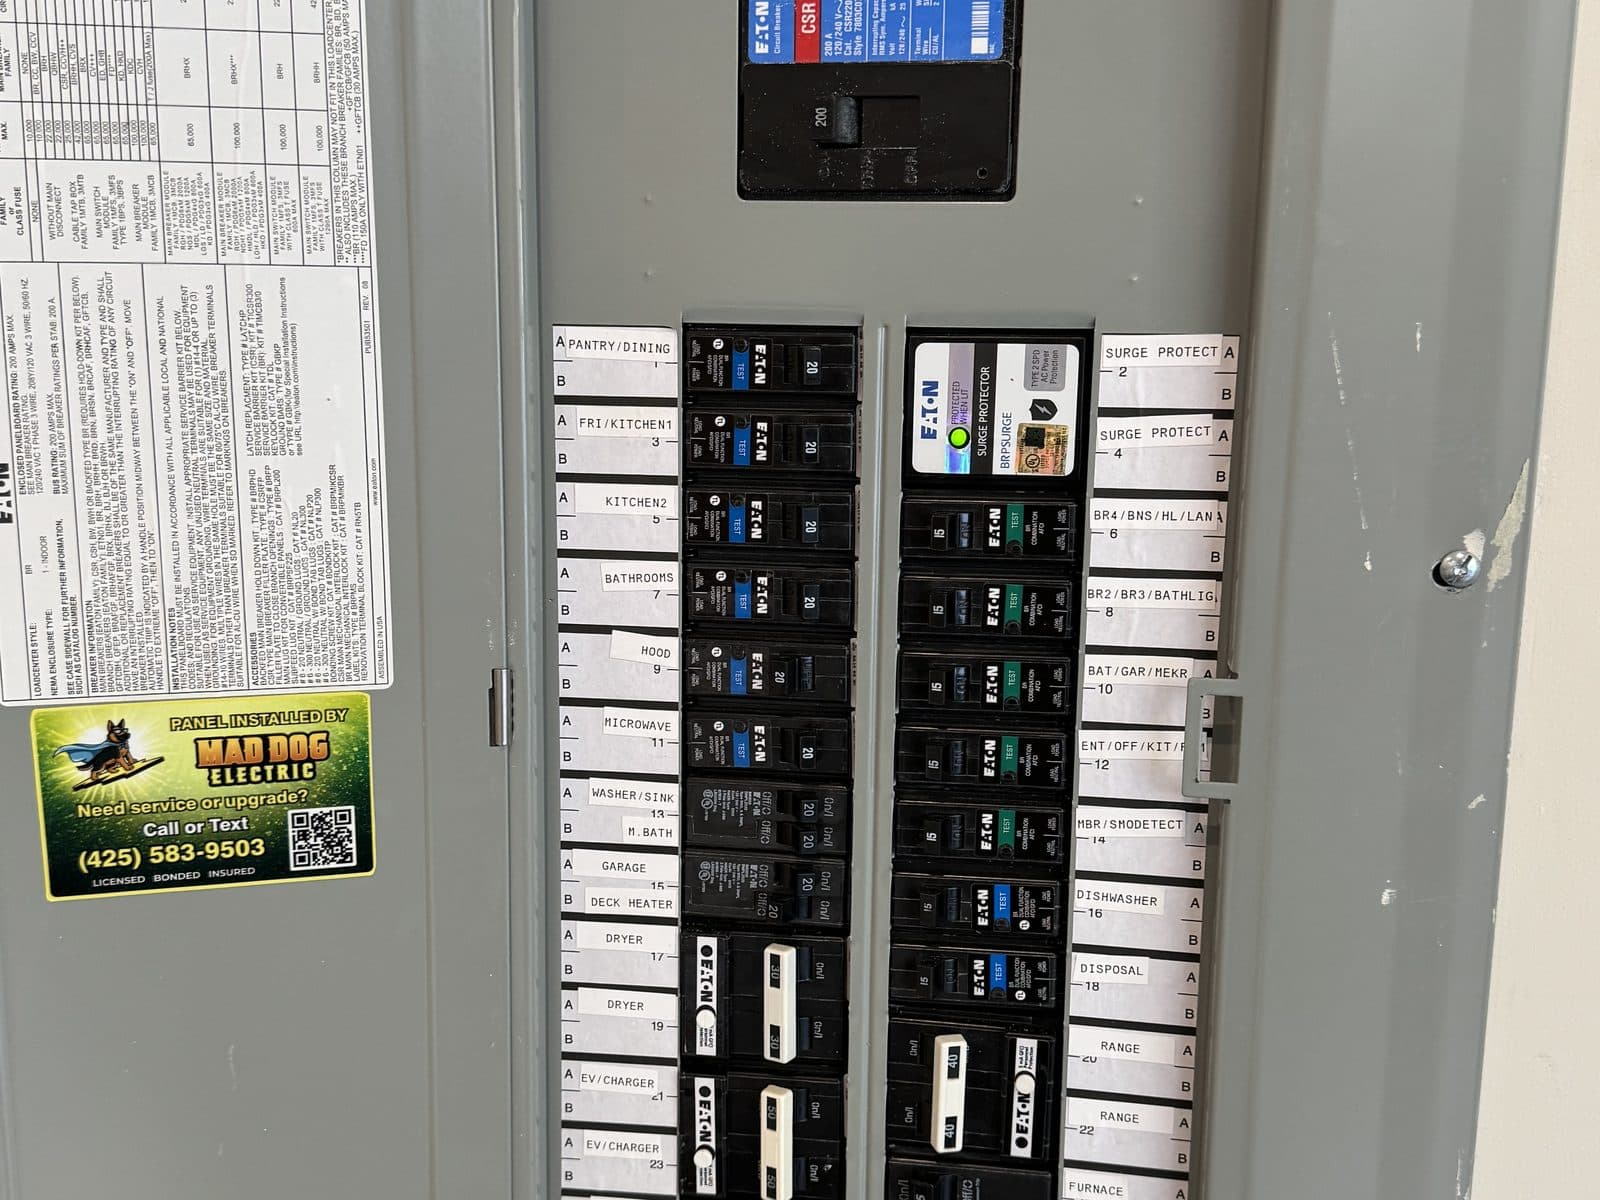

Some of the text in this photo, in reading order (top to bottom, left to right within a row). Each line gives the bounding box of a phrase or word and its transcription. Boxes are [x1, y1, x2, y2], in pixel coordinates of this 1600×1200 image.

[802, 3, 816, 33] CSR
[834, 21, 843, 56] 120/240
[854, 38, 863, 56] Style
[4, 48, 12, 77] FAMILY
[276, 63, 284, 80] BRH
[815, 108, 827, 126] 200
[316, 125, 324, 152] 100,000
[9, 207, 15, 215] or
[14, 186, 24, 236] CLASS FUSE
[31, 199, 39, 222] NONE
[45, 182, 56, 240] WITHOUT MAIN
[54, 186, 65, 237] DISCONNECT
[69, 181, 80, 243] CABLE TAP BOX
[239, 309, 248, 342] LATCHP
[556, 336, 670, 353] A PANTRY/DINING
[1032, 350, 1040, 365] SPD
[1106, 346, 1234, 358] SURGE PROTECT A
[241, 350, 249, 371] TYPE
[806, 361, 819, 374] 20
[1040, 350, 1049, 382] AC Power
[1049, 350, 1058, 384] Protection
[1119, 367, 1127, 377] 2
[557, 376, 565, 386] B
[1222, 389, 1231, 400] B
[951, 381, 960, 425] PROTECTED
[959, 399, 968, 425] WHEN
[978, 366, 990, 456] SURGE PROTECTOR
[557, 415, 671, 429] A FRI/KITCHEN1
[1000, 412, 1012, 469] BRPSURGE
[1101, 426, 1228, 441] SURGE PROTECT A
[246, 432, 254, 456] LATCH
[652, 437, 659, 446] 3
[805, 441, 817, 454] 20
[1114, 448, 1122, 458] 4
[370, 457, 379, 506] www.eaton.com
[606, 497, 666, 508] KITCHEN2
[653, 515, 660, 524] 5
[1011, 511, 1019, 529] TEST
[1094, 510, 1212, 522] BR4/BNS/HL/LAN
[805, 520, 817, 534] 20
[1110, 529, 1117, 538] 6
[605, 573, 673, 583] BATHROOMS
[653, 590, 660, 599] 7
[1087, 588, 1214, 601] BR2/BR3/BATHLIG
[804, 596, 816, 610] 20
[40, 535, 58, 696] NEMA ENCLOSURE TYPE: INDOOR
[1106, 607, 1113, 617] 8
[376, 616, 384, 630] USA
[25, 565, 42, 696] LOADCENTER STYLE: BR
[85, 600, 98, 693] BREAKER INFORMATION
[168, 607, 180, 690] INSTALLATION NOTES
[642, 646, 670, 658] HOOD
[377, 639, 385, 679] ASSEMBLED
[654, 665, 660, 674] 9
[1088, 665, 1188, 679] BAT/GAR/MEKR
[774, 671, 785, 684] 20
[1099, 684, 1112, 694] 10
[170, 709, 348, 731] PANEL INSTALLED BY
[605, 718, 671, 731] MICROWAVE
[196, 732, 328, 767] MAD DOG
[652, 738, 663, 747] 11
[1095, 759, 1109, 770] 12
[210, 763, 316, 786] ELECTRIC
[592, 788, 673, 803] WASHER/SINK
[77, 790, 308, 818] Need service or upgrade?
[143, 818, 249, 838] Call or Text
[1078, 818, 1184, 829] MBR/SMODETECT
[629, 827, 672, 837] M.BATH
[78, 838, 265, 873] (425) 583-9503
[602, 862, 646, 872] GARAGE
[93, 867, 256, 887] LICENSED BONDED INSURED
[592, 898, 672, 909] DECK HEATER
[1077, 890, 1157, 906] DISHWASHER
[1089, 908, 1102, 918] 16
[606, 934, 642, 944] DRYER
[651, 952, 664, 961] 17
[770, 964, 780, 980] 30
[1081, 964, 1143, 975] DISPOSAL
[1086, 982, 1099, 991] 18
[608, 1000, 643, 1010] DRYER
[652, 1022, 663, 1031] 19
[1101, 1041, 1140, 1053] RANGE
[949, 1053, 958, 1069] 40
[582, 1074, 654, 1088] EV/CHARGER
[1101, 1111, 1139, 1123] RANGE
[1080, 1125, 1094, 1136] 22
[587, 1140, 659, 1153] EV/CHARGER
[650, 1160, 663, 1169] 23
[1069, 1182, 1123, 1196] FURNACE
